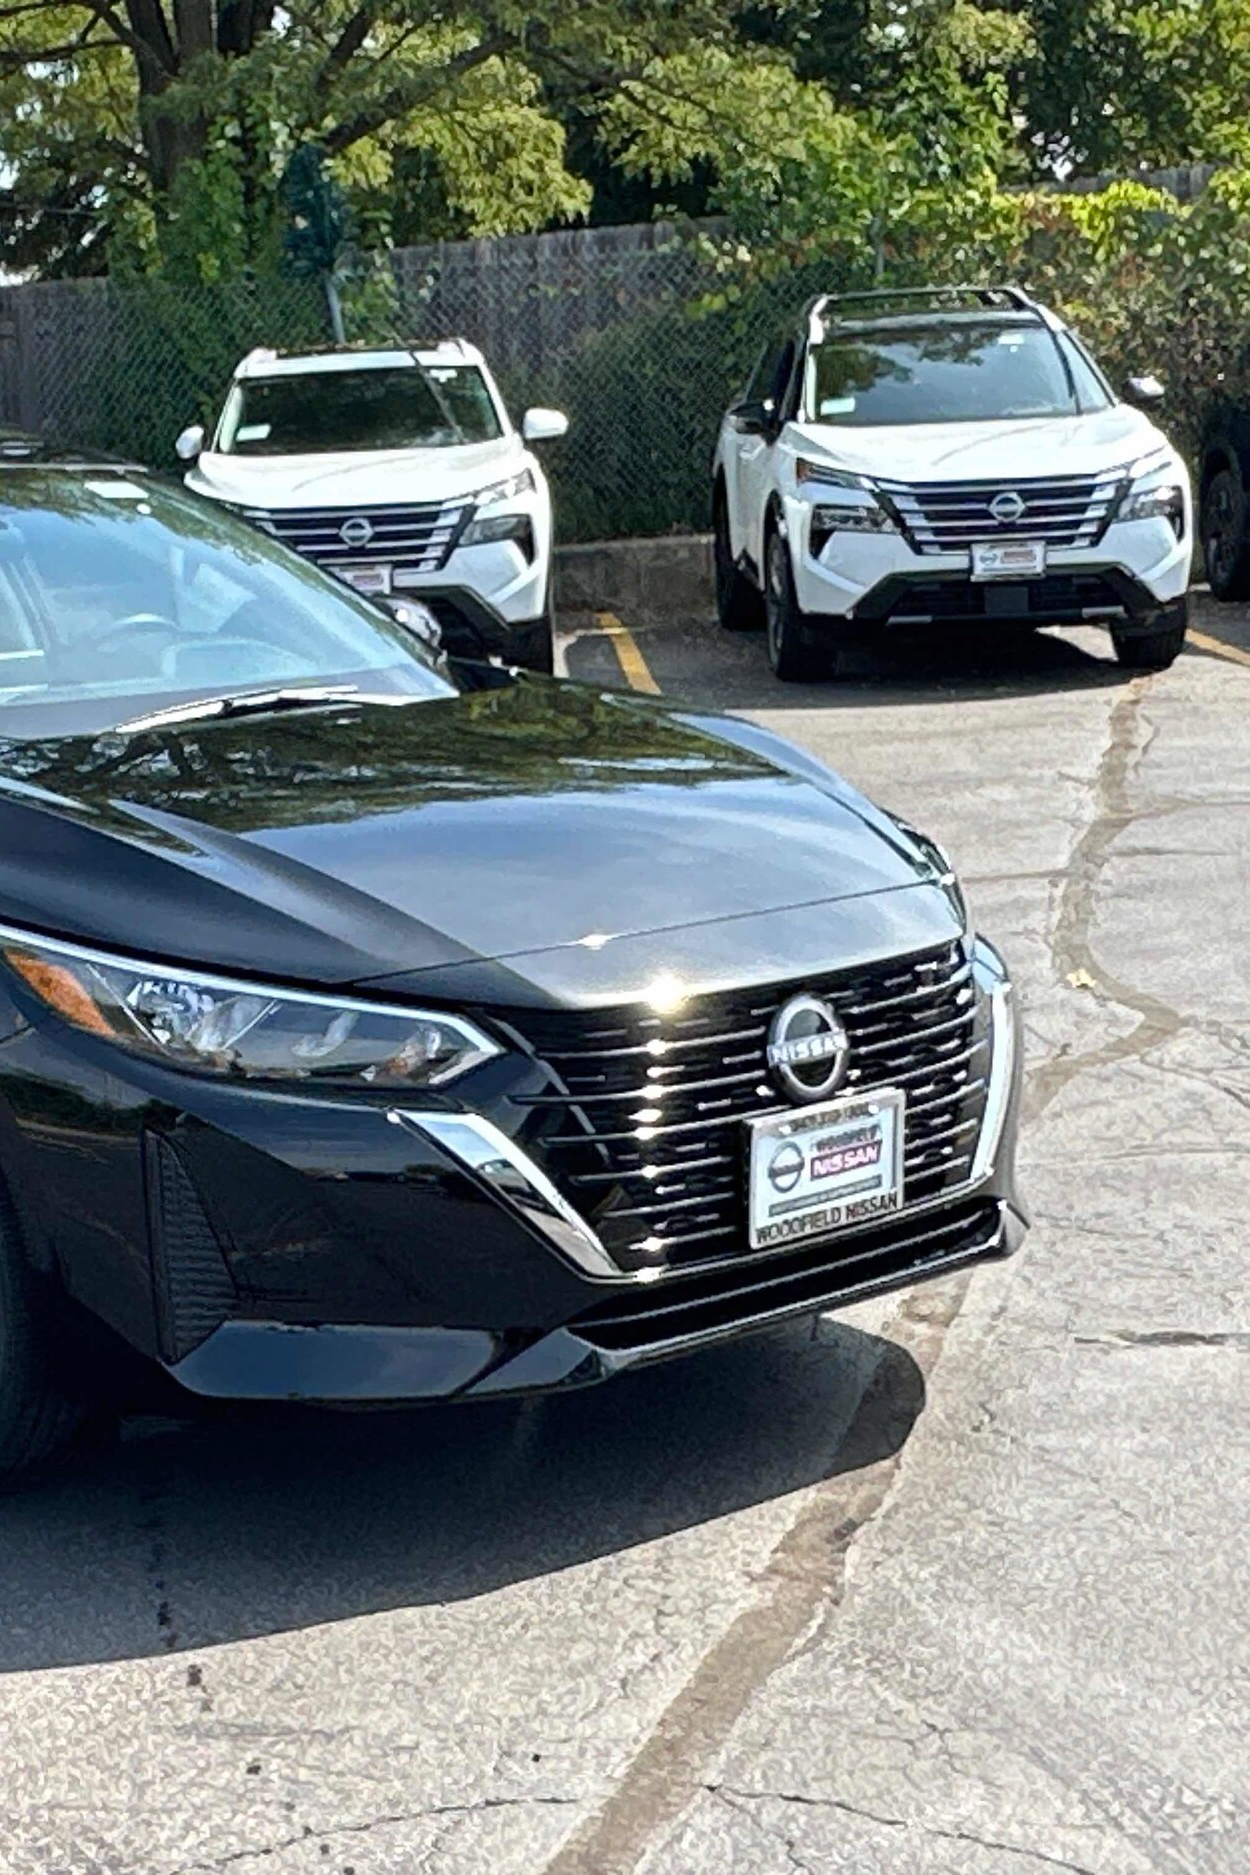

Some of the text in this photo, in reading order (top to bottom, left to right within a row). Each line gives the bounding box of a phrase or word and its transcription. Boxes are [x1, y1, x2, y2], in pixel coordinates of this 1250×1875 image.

[771, 1034, 847, 1063] NISSAN
[813, 1144, 879, 1177] NISSAN
[846, 1190, 898, 1220] NISSAN
